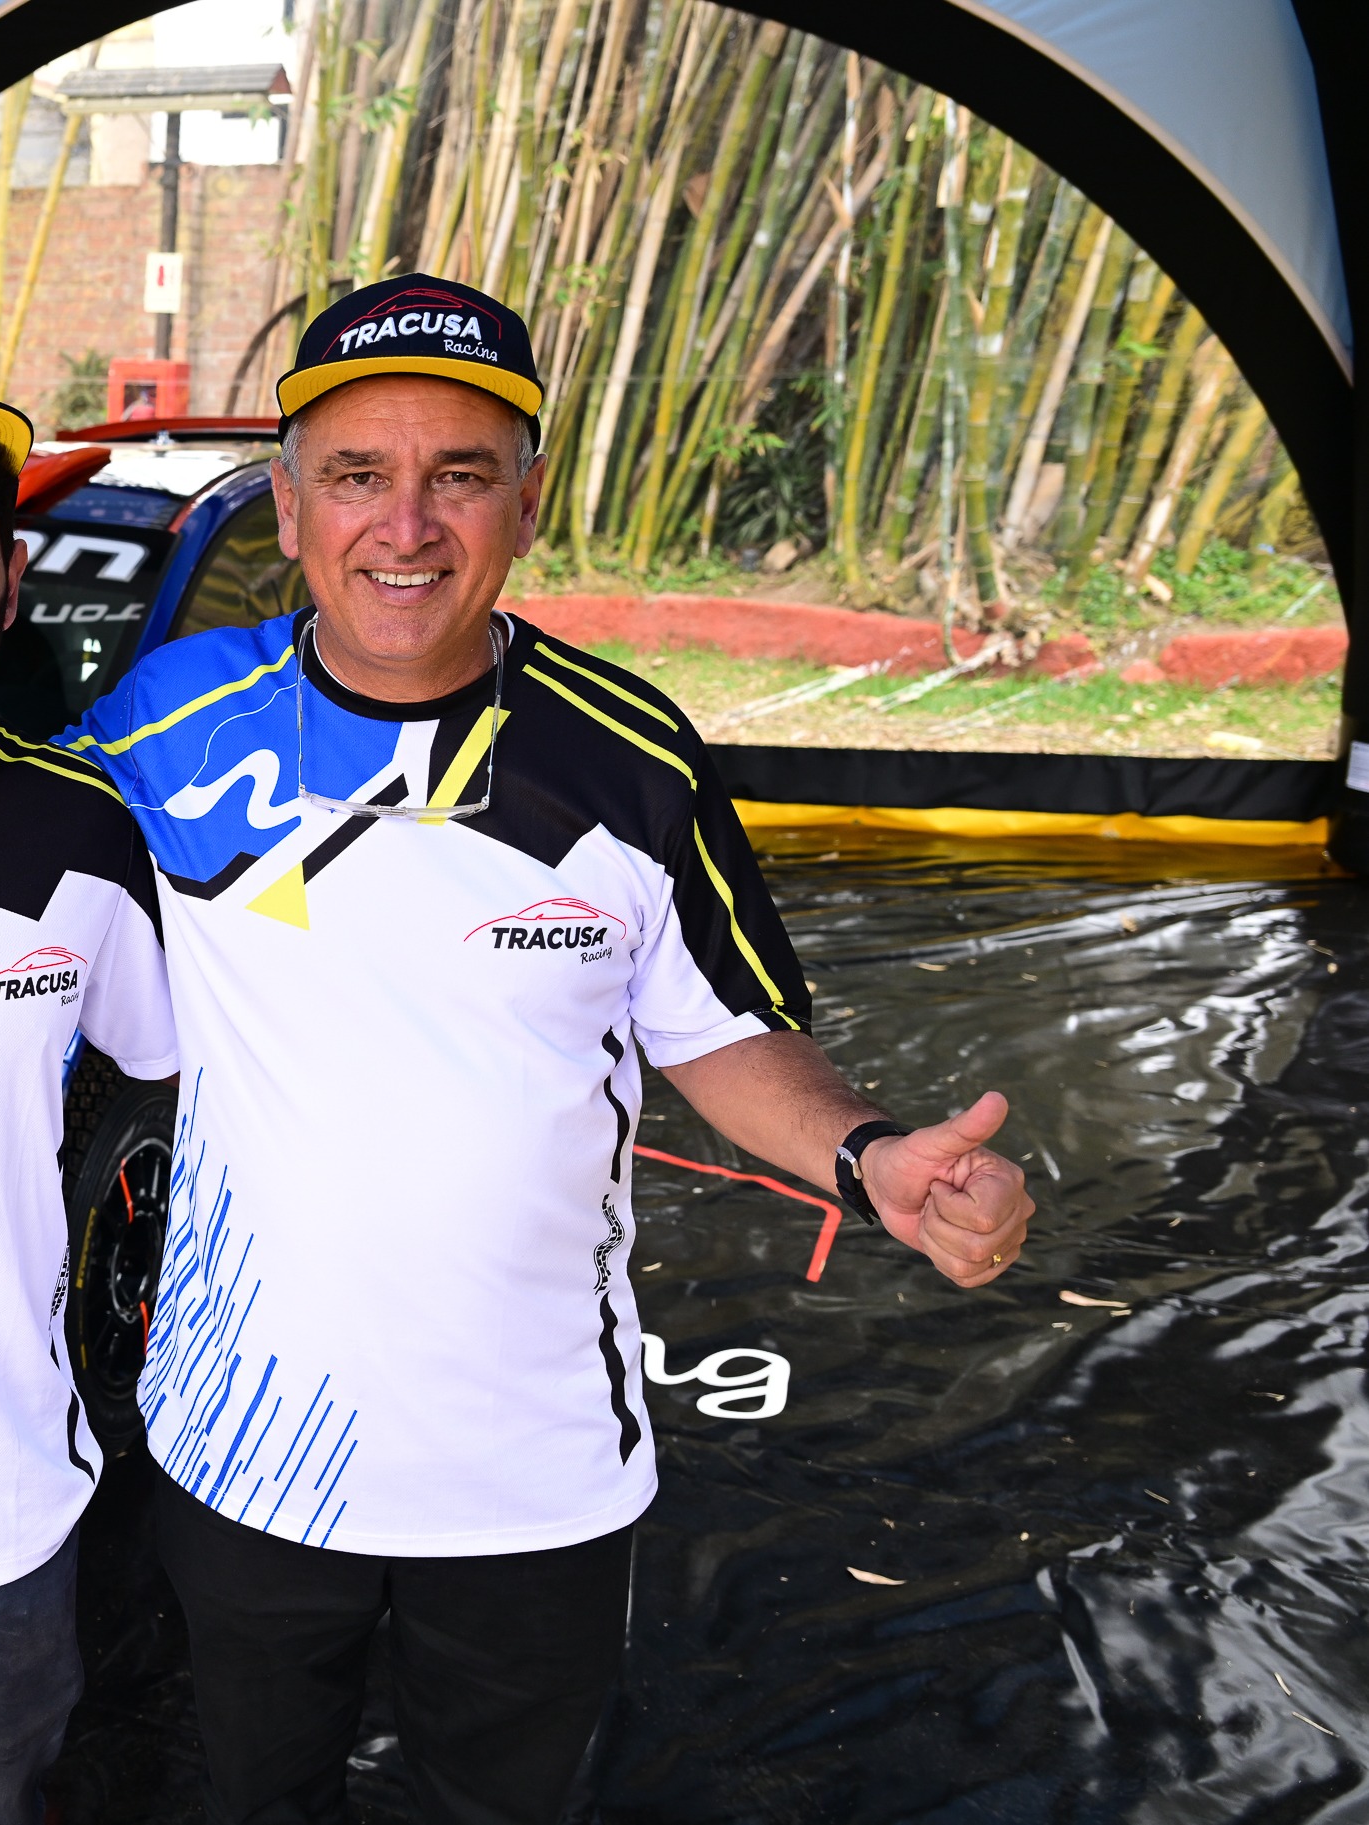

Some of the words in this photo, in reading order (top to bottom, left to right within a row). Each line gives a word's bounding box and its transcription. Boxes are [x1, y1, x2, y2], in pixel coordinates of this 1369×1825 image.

[340, 312, 481, 354] TRACUSA
[444, 340, 498, 361] Racing
[491, 927, 607, 950] TRACUSA
[581, 946, 612, 964] Racing
